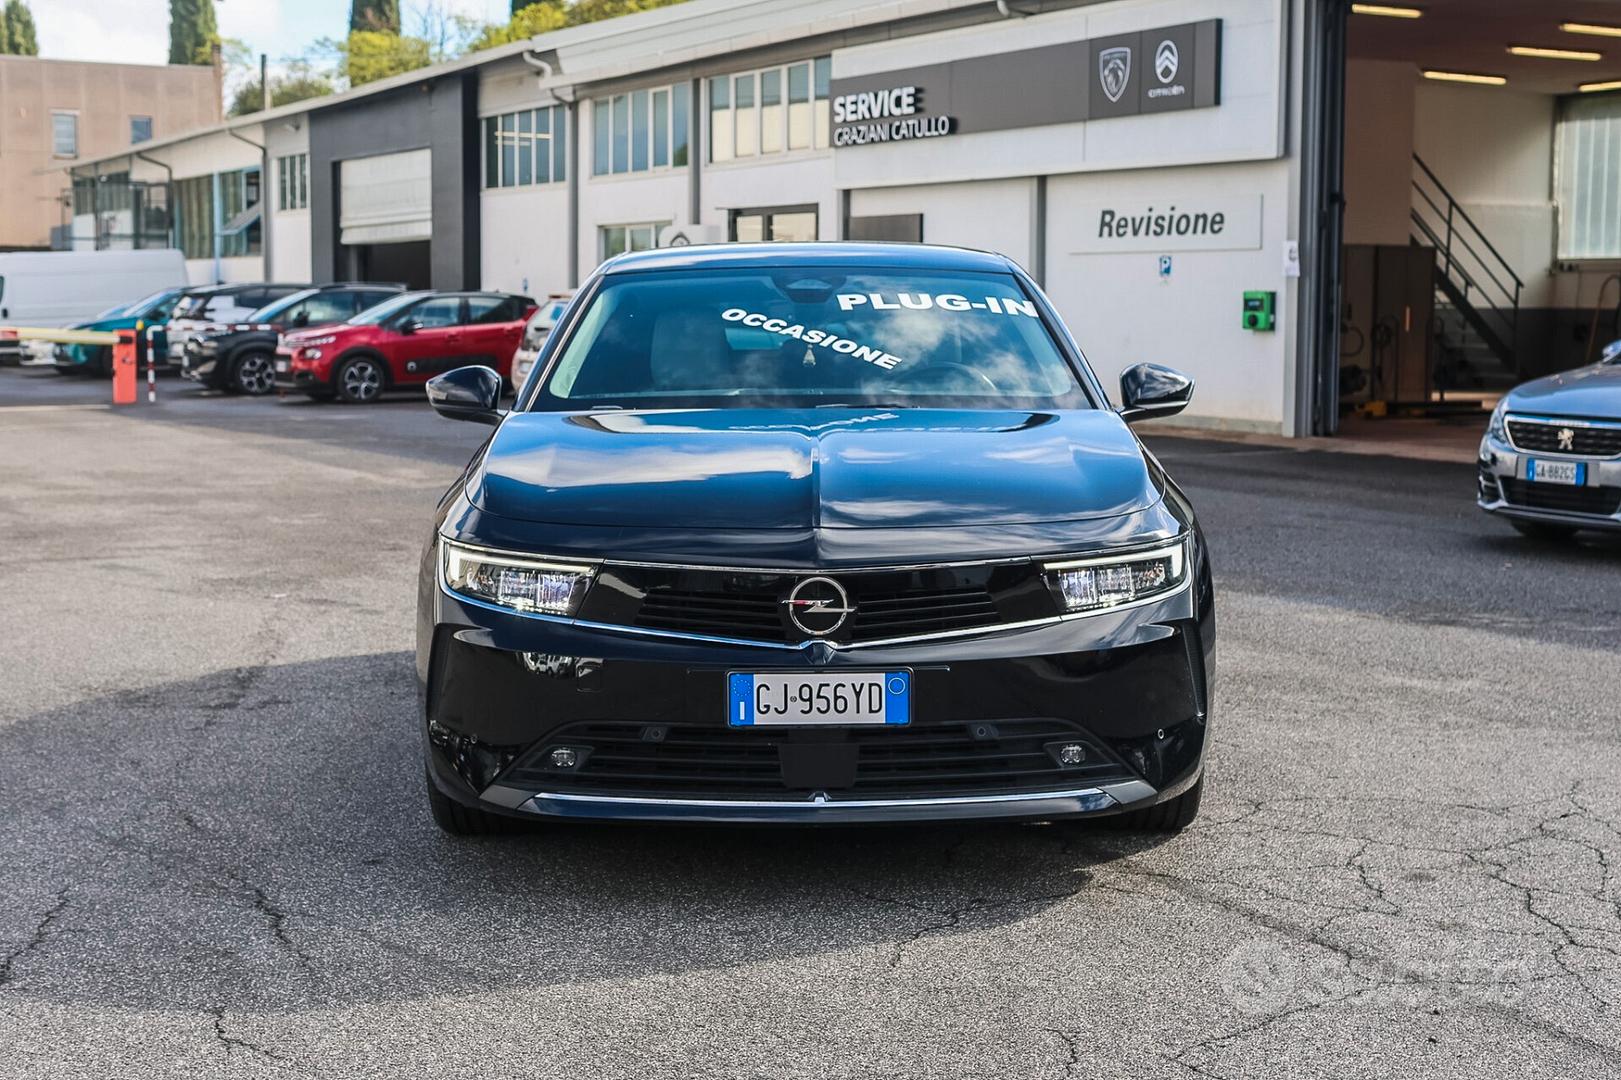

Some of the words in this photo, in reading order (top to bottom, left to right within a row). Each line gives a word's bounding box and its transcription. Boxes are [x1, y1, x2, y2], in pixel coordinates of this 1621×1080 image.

[833, 86, 915, 123] SERVICE
[834, 123, 890, 146] GRAZIANI
[891, 115, 949, 140] CATULLO
[1098, 206, 1225, 238] Revisione
[836, 293, 1039, 318] PLUG-IN
[721, 308, 902, 370] OCCASIONE
